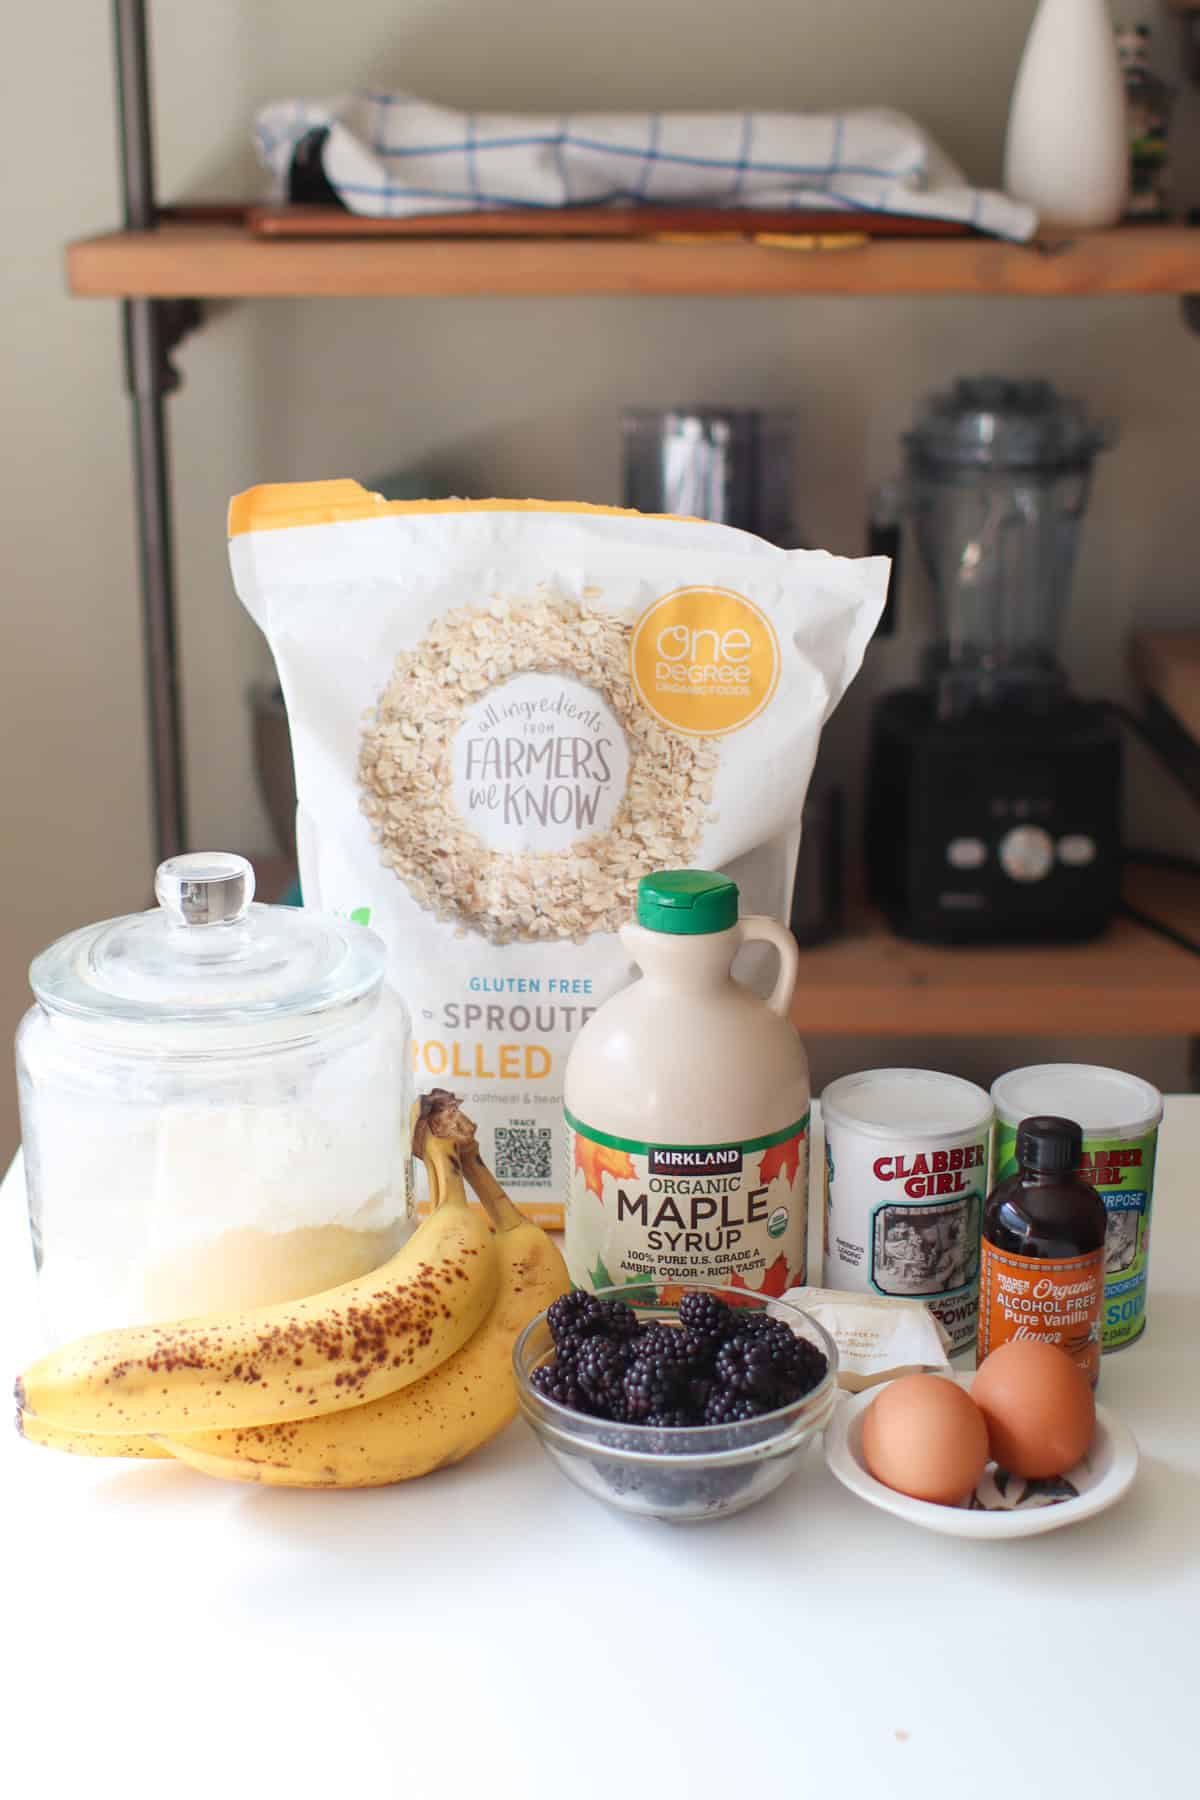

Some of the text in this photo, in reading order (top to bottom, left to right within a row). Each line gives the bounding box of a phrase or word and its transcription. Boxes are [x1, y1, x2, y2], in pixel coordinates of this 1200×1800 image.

[479, 691, 605, 732] all ingredients
[523, 722, 555, 735] FROM
[465, 736, 613, 782] FARMERS
[469, 783, 603, 830] we KNOW
[469, 976, 593, 995] GLUTEN FREE
[443, 1002, 597, 1032] SPROUTE
[653, 1150, 739, 1166] KIRKLAND
[873, 1144, 984, 1181] CLABBER
[1078, 1149, 1143, 1169] ABBER
[649, 1176, 741, 1195] ORGANIC
[904, 1171, 967, 1198] GIRL
[617, 1187, 769, 1230] MAPLE
[1103, 1193, 1144, 1208] RPOSE
[647, 1229, 742, 1253] SYRUP
[620, 1258, 766, 1278] AMBER COLOR RICH TASTE
[627, 1249, 760, 1266] 100% PURE U.S. GRADE A
[1032, 1274, 1097, 1301] Organic
[932, 1301, 977, 1325] POWD
[996, 1292, 1097, 1313] ALCOHOL FREE
[1004, 1309, 1088, 1327] Pure Vanilla
[1006, 1325, 1063, 1344] flavor
